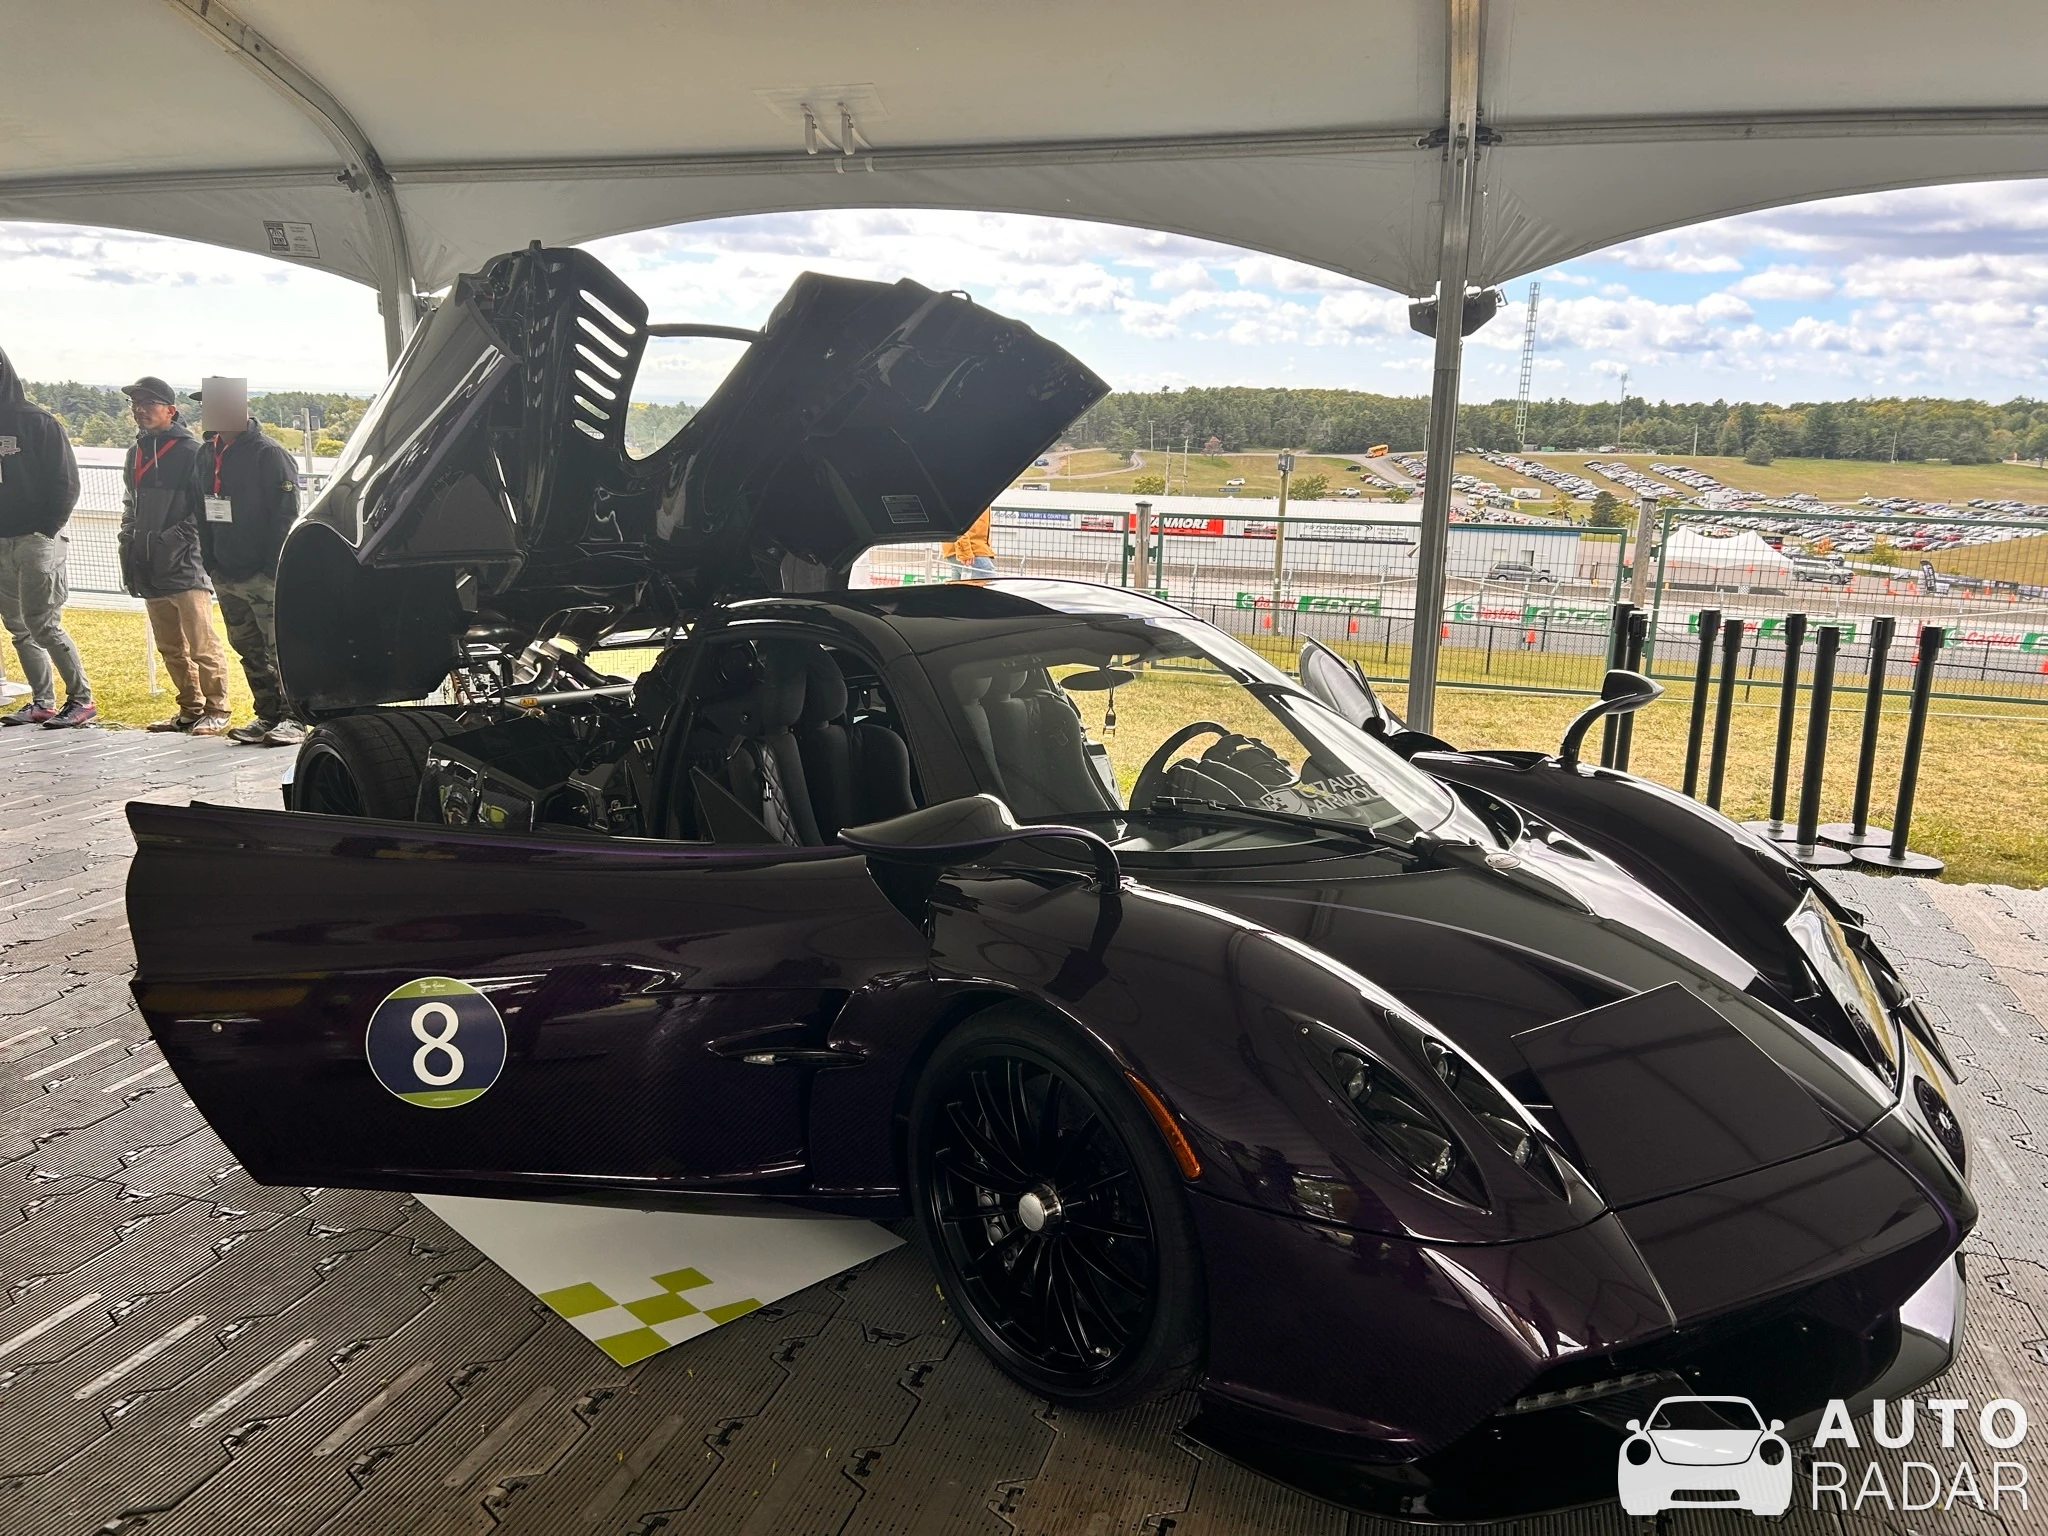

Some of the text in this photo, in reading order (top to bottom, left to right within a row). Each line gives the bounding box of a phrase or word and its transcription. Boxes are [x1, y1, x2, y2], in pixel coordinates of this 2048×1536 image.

[1476, 606, 1522, 621] Castrol
[1966, 631, 2020, 647] Castrol
[411, 1001, 465, 1086] 8
